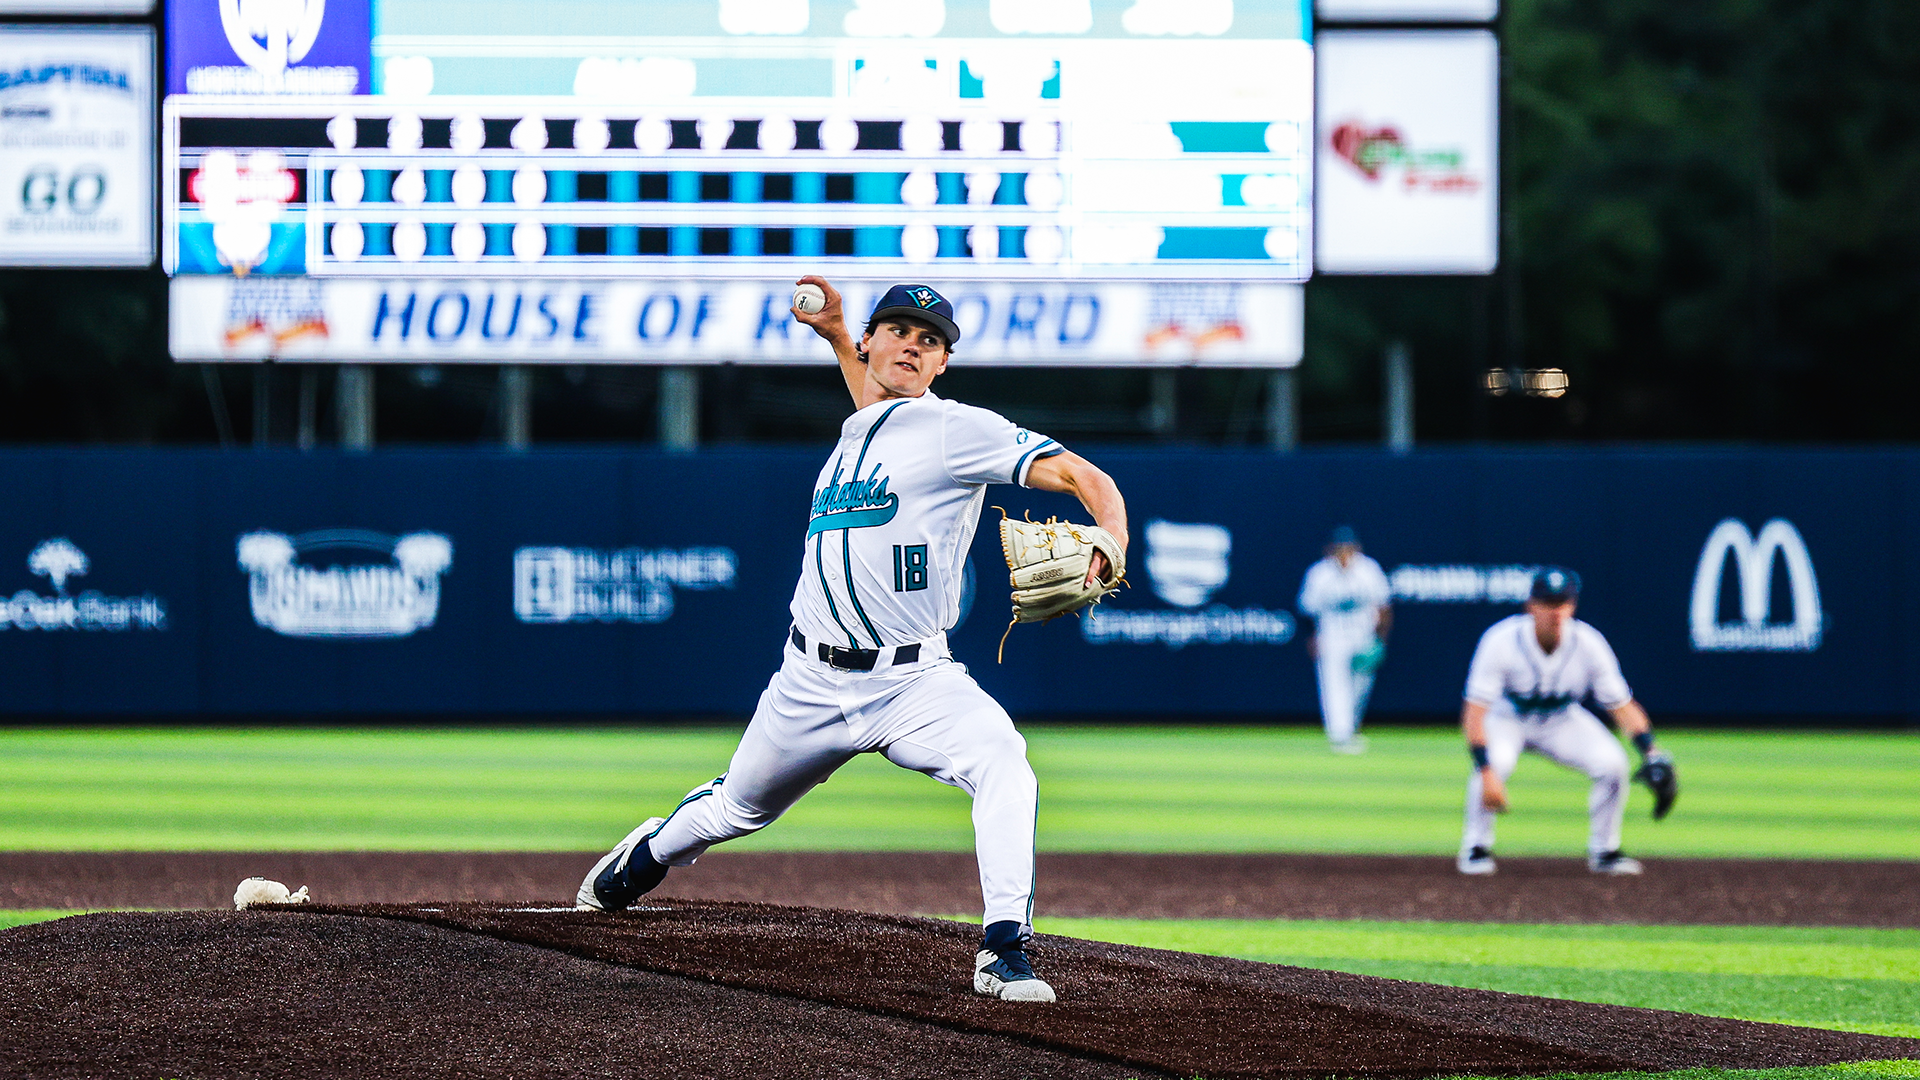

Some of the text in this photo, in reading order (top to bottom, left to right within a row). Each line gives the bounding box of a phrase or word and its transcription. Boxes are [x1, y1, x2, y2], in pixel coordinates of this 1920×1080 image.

[21, 163, 108, 216] GO
[372, 292, 600, 342] HOUSE
[637, 292, 723, 342] OF
[755, 291, 1102, 343] RORD
[892, 544, 928, 592] 18
